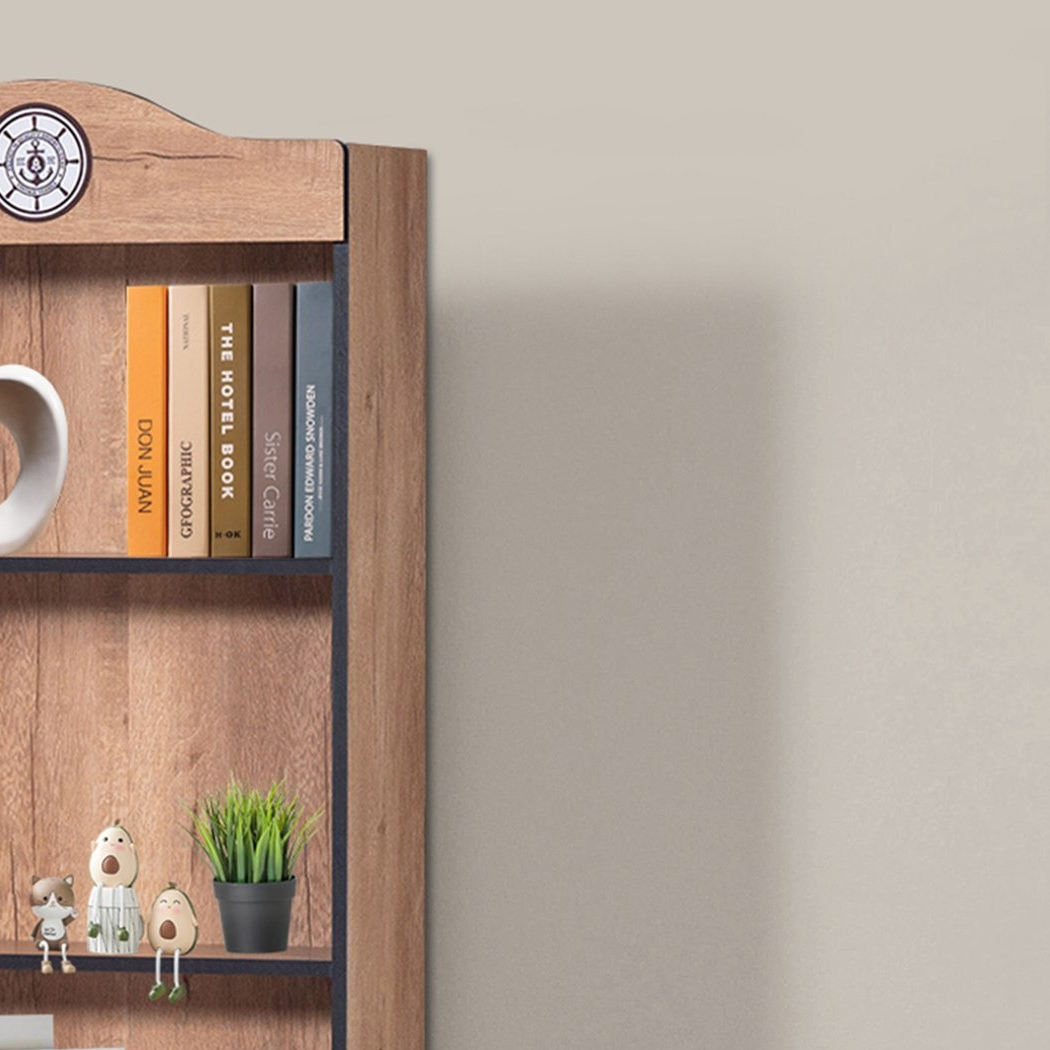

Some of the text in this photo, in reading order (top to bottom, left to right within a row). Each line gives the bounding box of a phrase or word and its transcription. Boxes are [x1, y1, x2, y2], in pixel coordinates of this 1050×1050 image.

[138, 419, 153, 514] DON JUAN
[221, 322, 234, 500] THE HOTEL BOOK
[303, 385, 316, 542] PARDON EDWARD SNOWDEN
[262, 431, 282, 540] Sister Carrie
